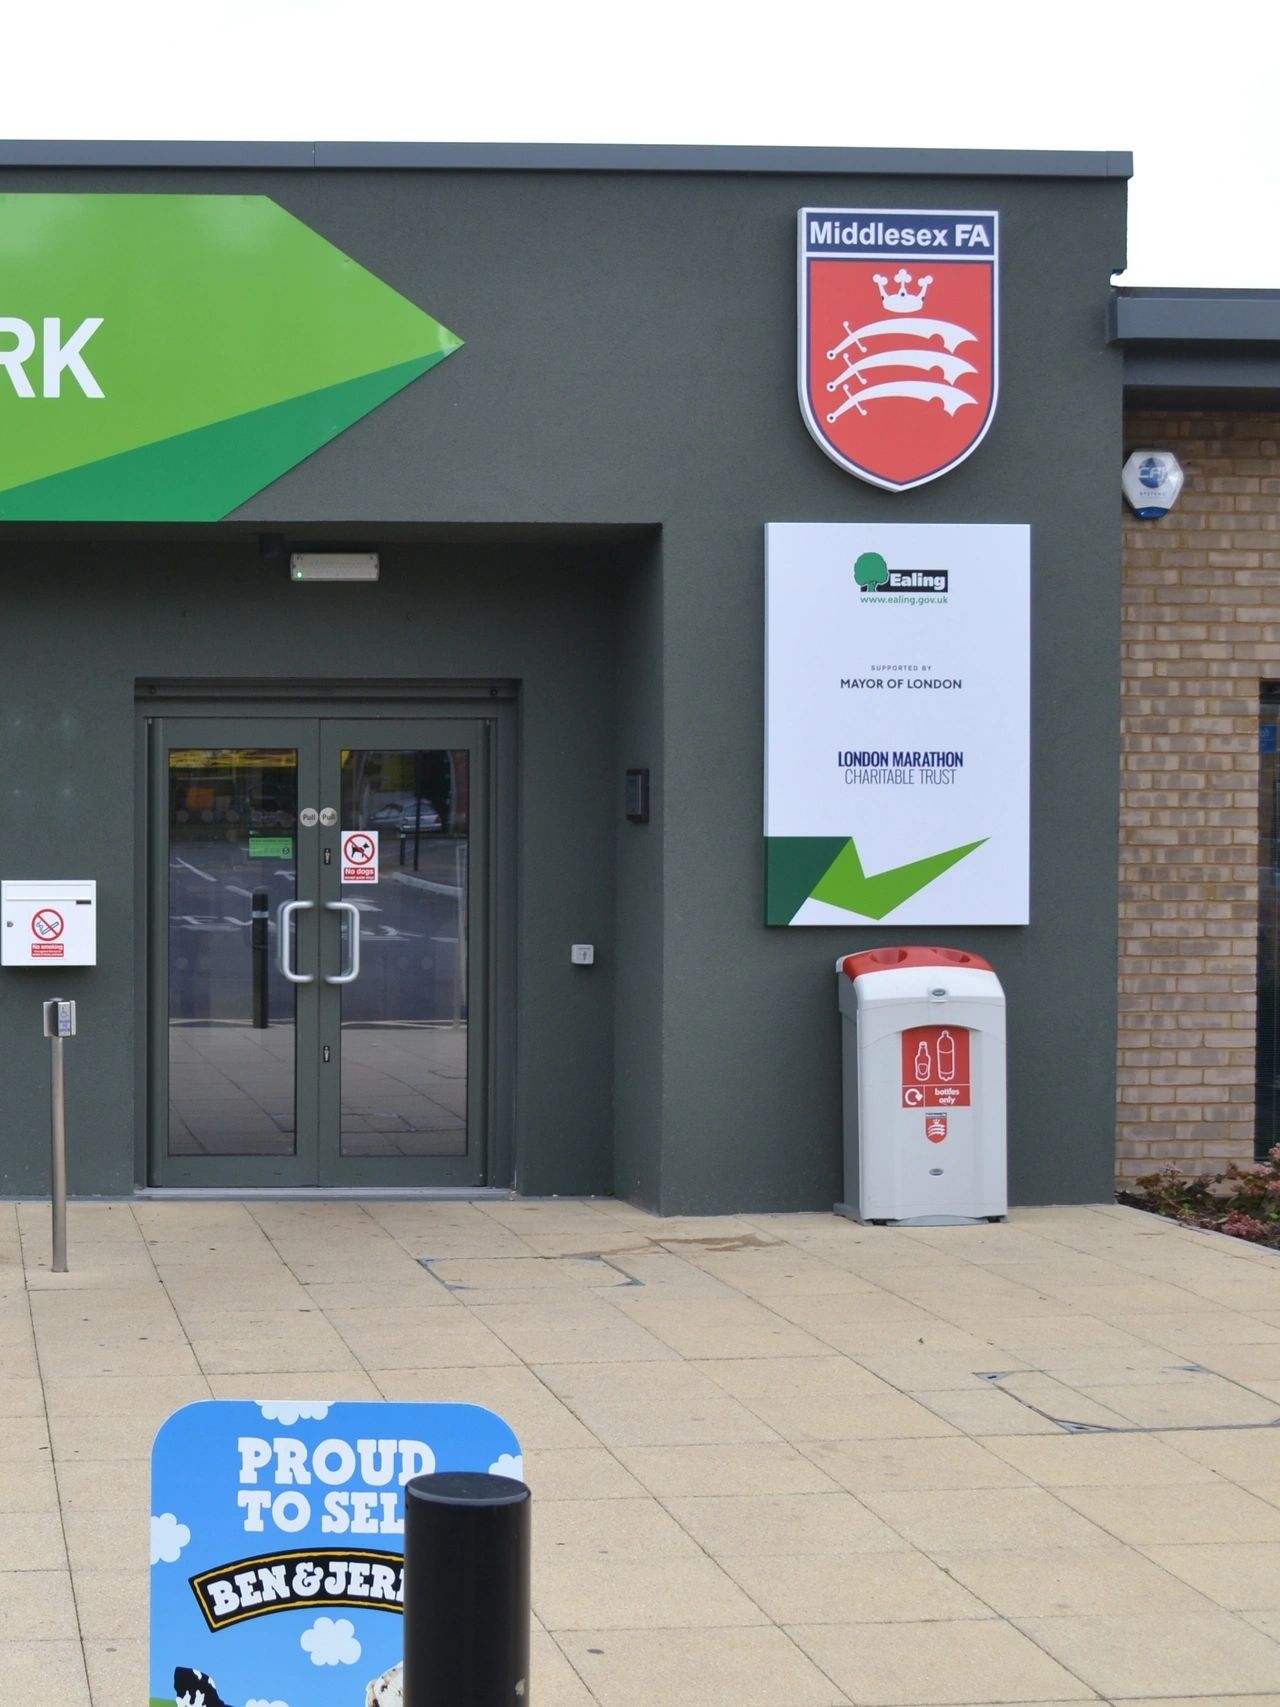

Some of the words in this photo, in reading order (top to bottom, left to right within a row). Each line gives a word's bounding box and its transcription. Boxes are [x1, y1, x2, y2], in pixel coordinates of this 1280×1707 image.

[810, 221, 948, 246] Middlesex
[955, 224, 990, 247] FA
[889, 572, 946, 590] Ealing
[860, 595, 948, 606] www.ealing.gov.uk
[840, 679, 884, 689] MAYOR
[887, 679, 904, 689] OF
[907, 679, 962, 689] LONDON
[838, 751, 889, 767] LONDON
[892, 751, 964, 767] MARATHON
[845, 769, 915, 785] CHARITABLE
[919, 769, 957, 785] TRUST
[302, 813, 316, 821] Pull
[322, 813, 336, 821] Pull
[357, 868, 374, 877] dogs
[934, 1087, 960, 1096] bottles
[938, 1096, 956, 1105] only
[237, 1437, 436, 1487] PROUD
[237, 1490, 311, 1533] TO
[321, 1491, 405, 1534] SEL
[206, 1561, 404, 1617] BEN&JER
